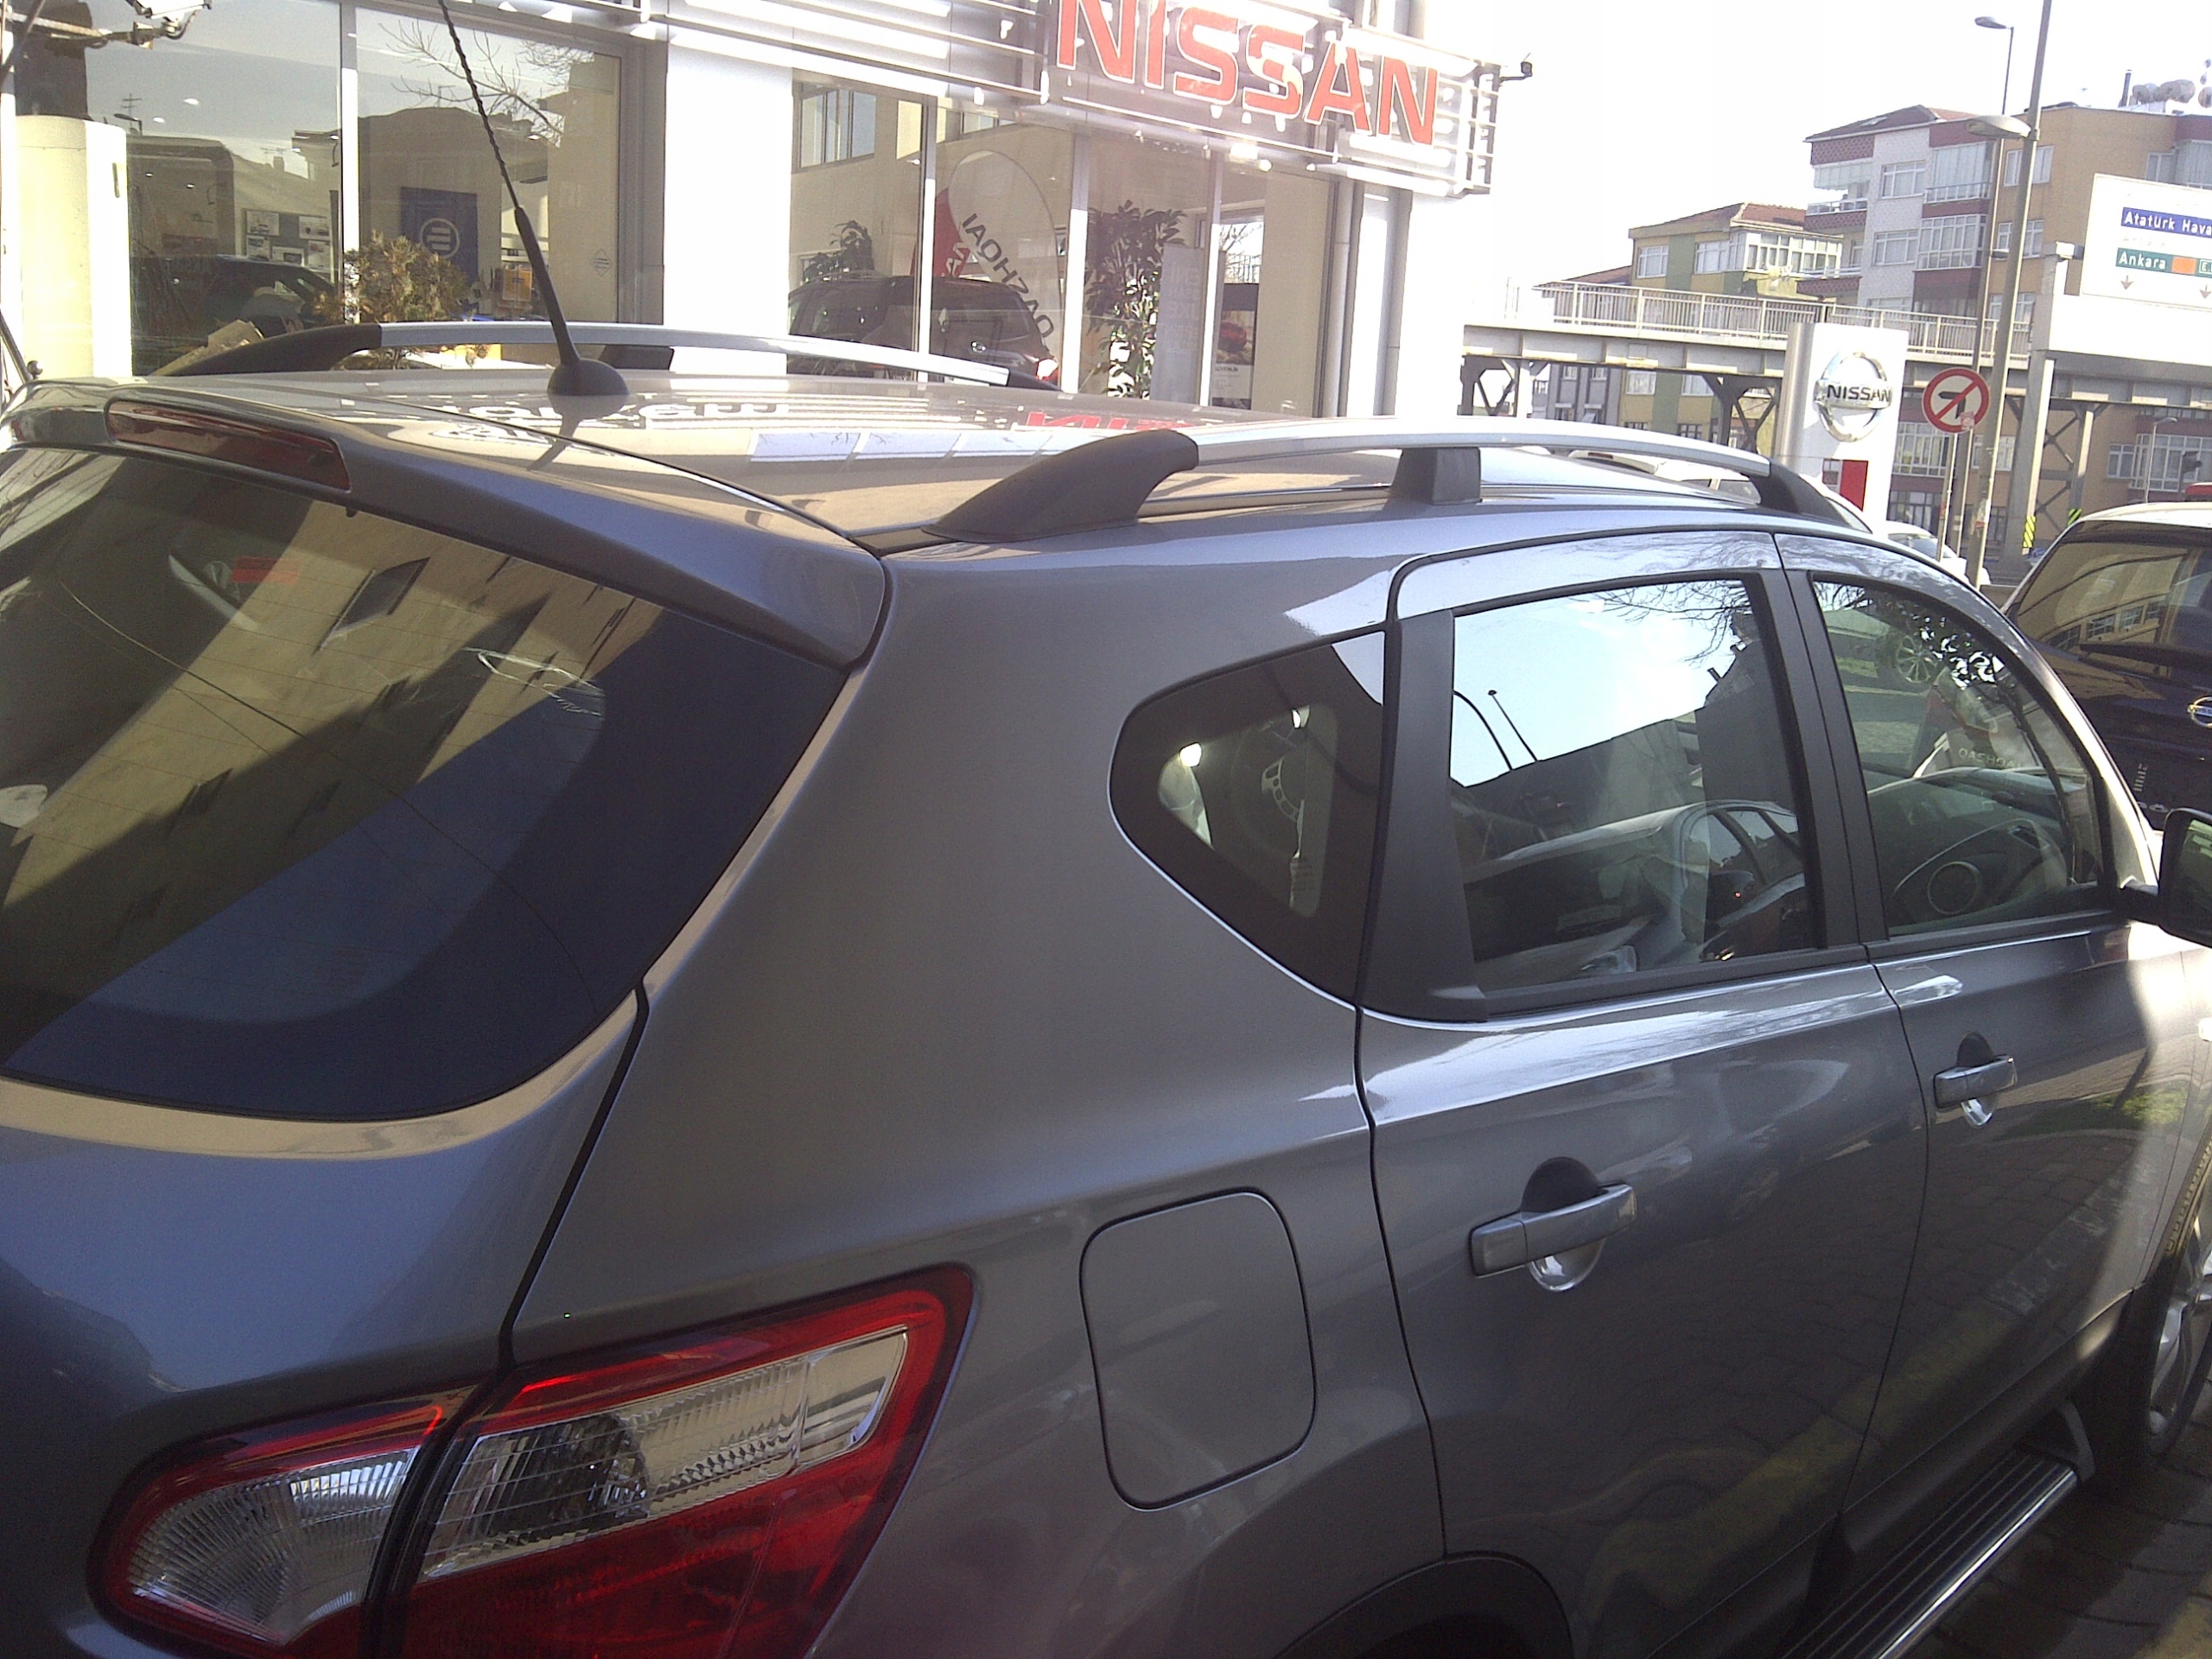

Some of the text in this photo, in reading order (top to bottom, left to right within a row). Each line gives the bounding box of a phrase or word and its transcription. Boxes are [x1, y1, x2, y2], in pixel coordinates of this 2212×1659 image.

[1057, 0, 1438, 145] NISSAN
[2124, 211, 2176, 231] Atatürk
[2119, 251, 2166, 270] Ankara
[1827, 384, 1891, 403] NISSAN
